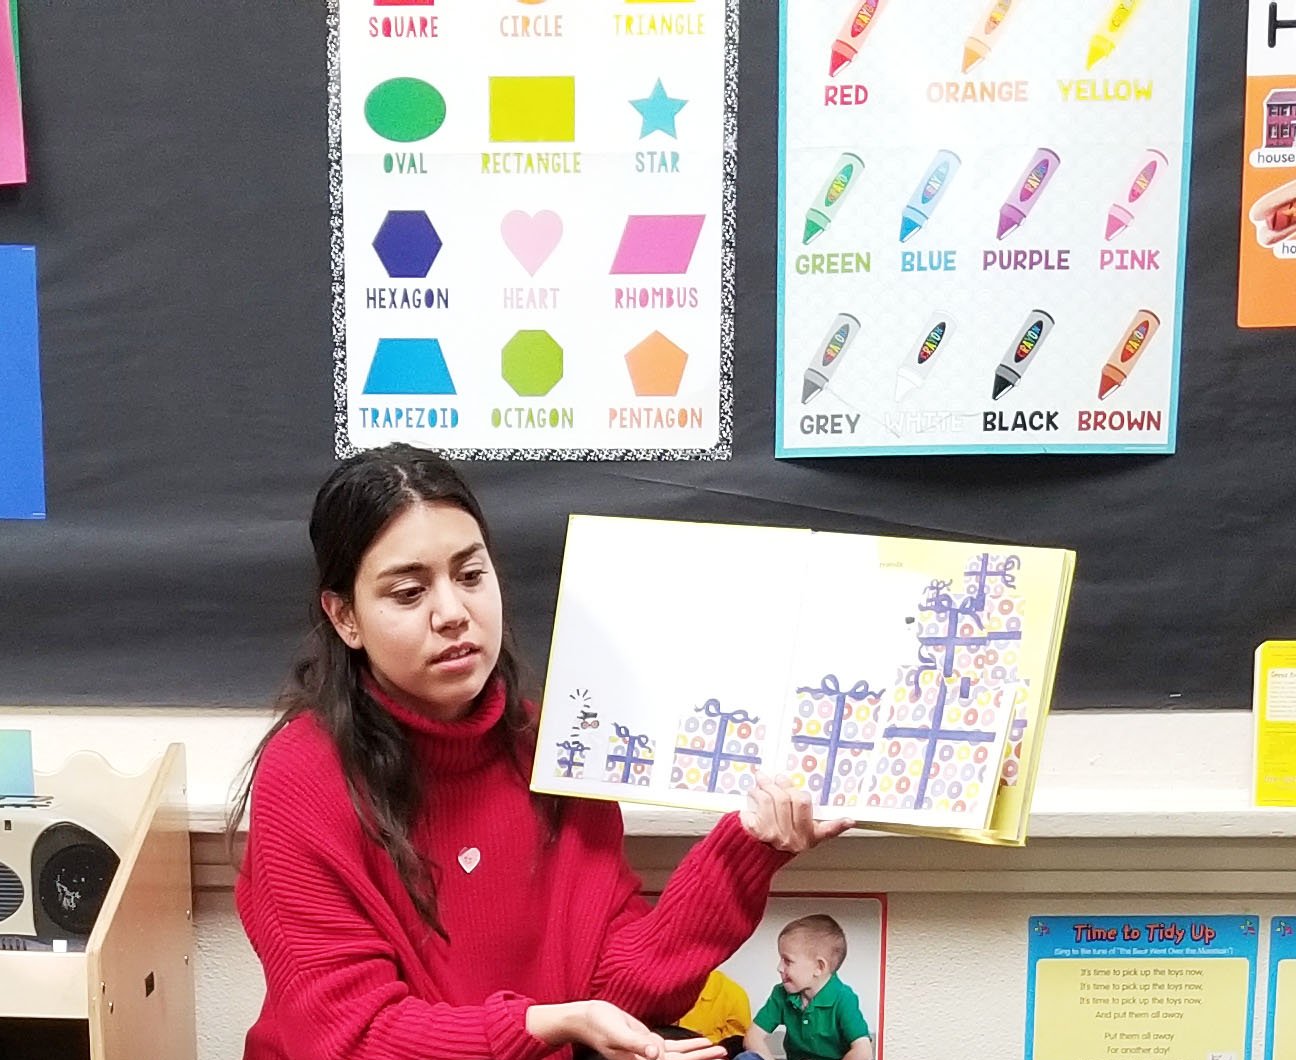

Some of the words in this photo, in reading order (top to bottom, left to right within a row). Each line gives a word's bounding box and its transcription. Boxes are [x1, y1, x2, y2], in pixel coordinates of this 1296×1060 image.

[369, 16, 438, 37] SQUARE
[500, 15, 562, 37] CIRCLE
[615, 14, 703, 35] TRIANGLE
[824, 85, 868, 106] RED
[928, 81, 1028, 103] ORANGE
[1060, 80, 1153, 101] YELLOW
[384, 153, 427, 174] OVAL
[480, 152, 581, 174] RECTANGLE
[636, 151, 680, 173] STAR
[1256, 150, 1296, 165] house
[795, 252, 871, 275] GREEN
[901, 251, 956, 272] BLUE
[983, 250, 1070, 270] PURPLE
[1100, 249, 1160, 270] PINK
[367, 288, 448, 308] HEXAGON
[504, 288, 560, 309] HEART
[615, 287, 698, 308] RHOMBUS
[359, 408, 458, 428] TRAPEZOID
[491, 408, 573, 428] OCTAGON
[609, 408, 702, 428] PENTAGON
[800, 414, 860, 434] GREY
[885, 411, 963, 433] WHITE
[983, 411, 1058, 431] BLACK
[1078, 411, 1161, 431] BROWN
[1073, 923, 1118, 944] Time
[1122, 924, 1140, 943] to
[1145, 922, 1185, 945] Tidy
[1190, 923, 1216, 945] Up
